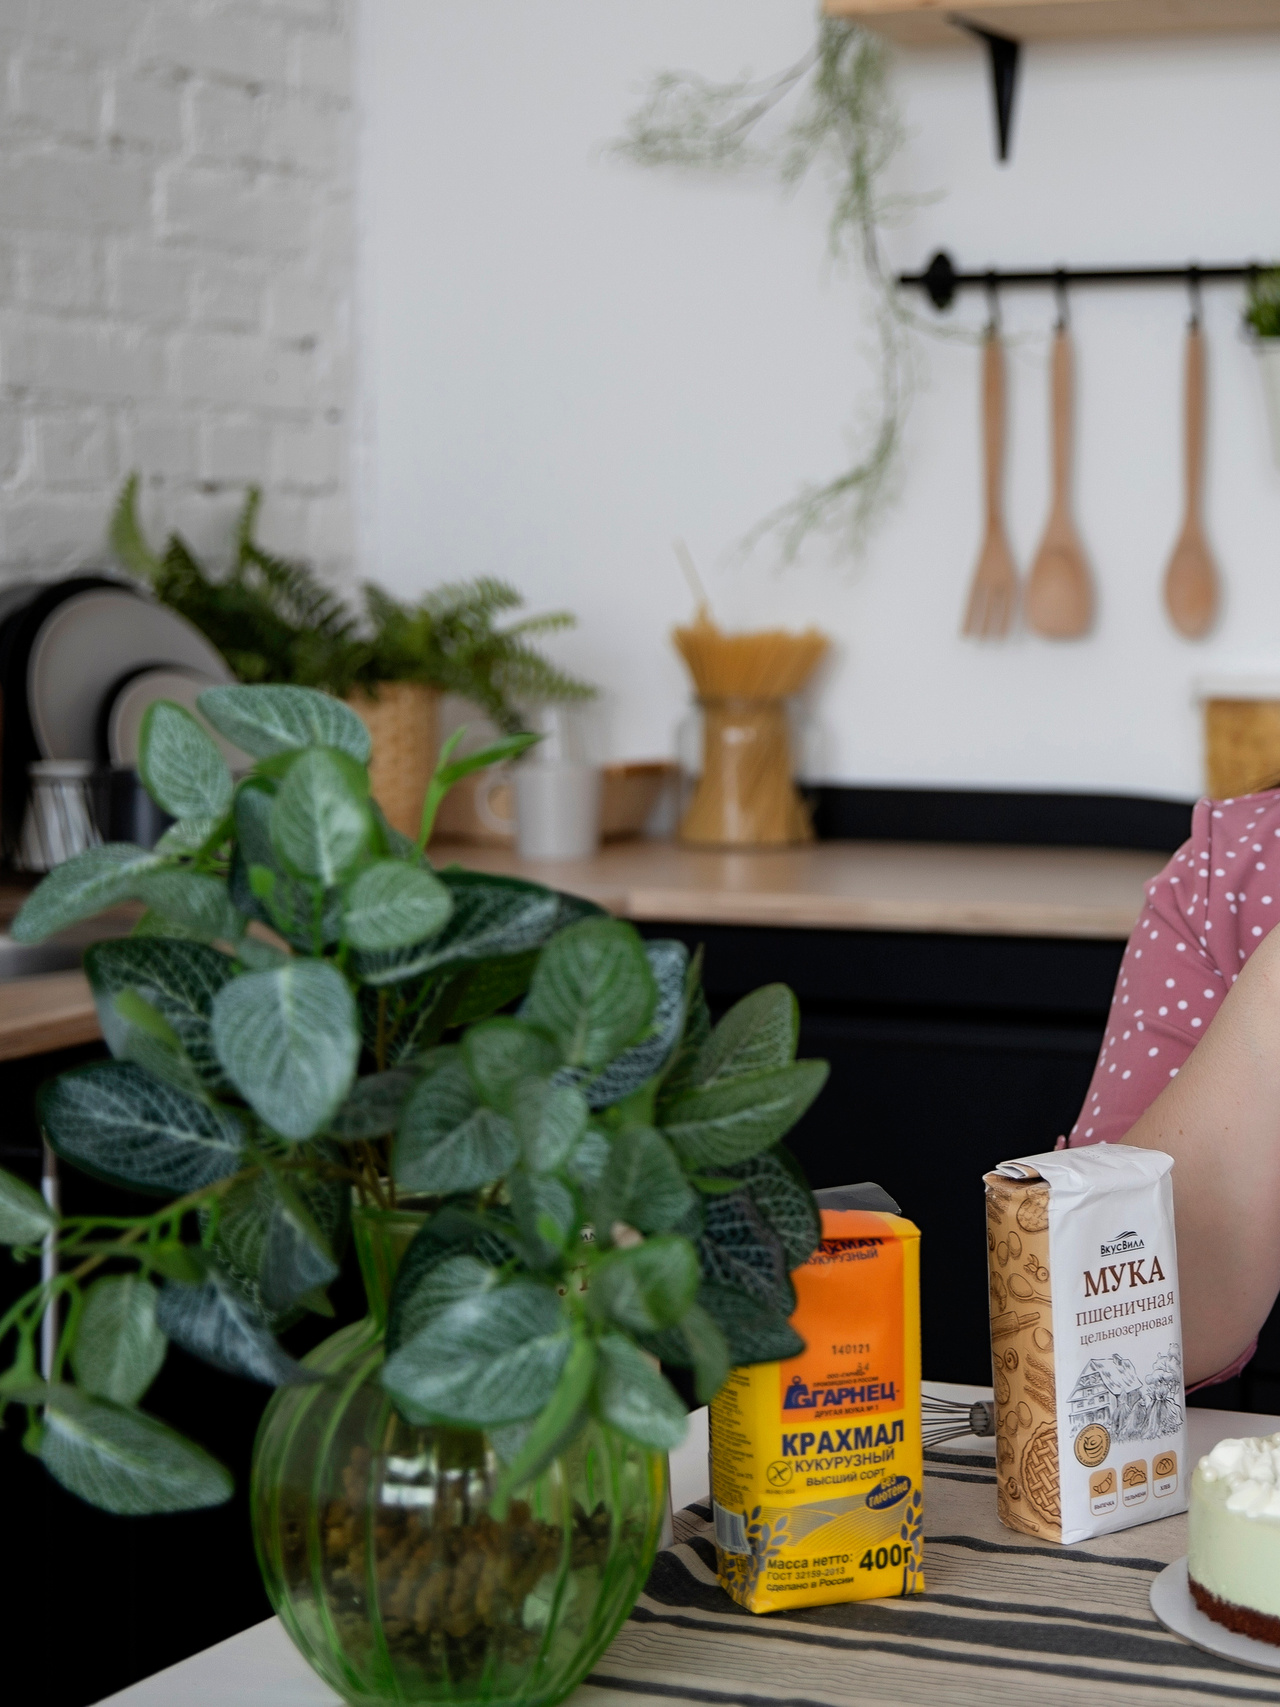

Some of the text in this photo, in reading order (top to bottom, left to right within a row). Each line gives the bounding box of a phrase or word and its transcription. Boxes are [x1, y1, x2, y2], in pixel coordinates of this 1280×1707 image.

[1082, 1255, 1166, 1298] МУКА
[1075, 1290, 1175, 1327] пшеничная
[1080, 1314, 1174, 1347] цельнозерновая
[831, 1343, 870, 1355] 140121
[781, 1419, 904, 1457] КРАХМАЛ
[795, 1445, 895, 1473] КУКУРУЗНЫЙ
[806, 1467, 886, 1487] ВЫСШИЙ СОРТ
[859, 1543, 913, 1571] 400г
[766, 1571, 792, 1580] ГОСТ
